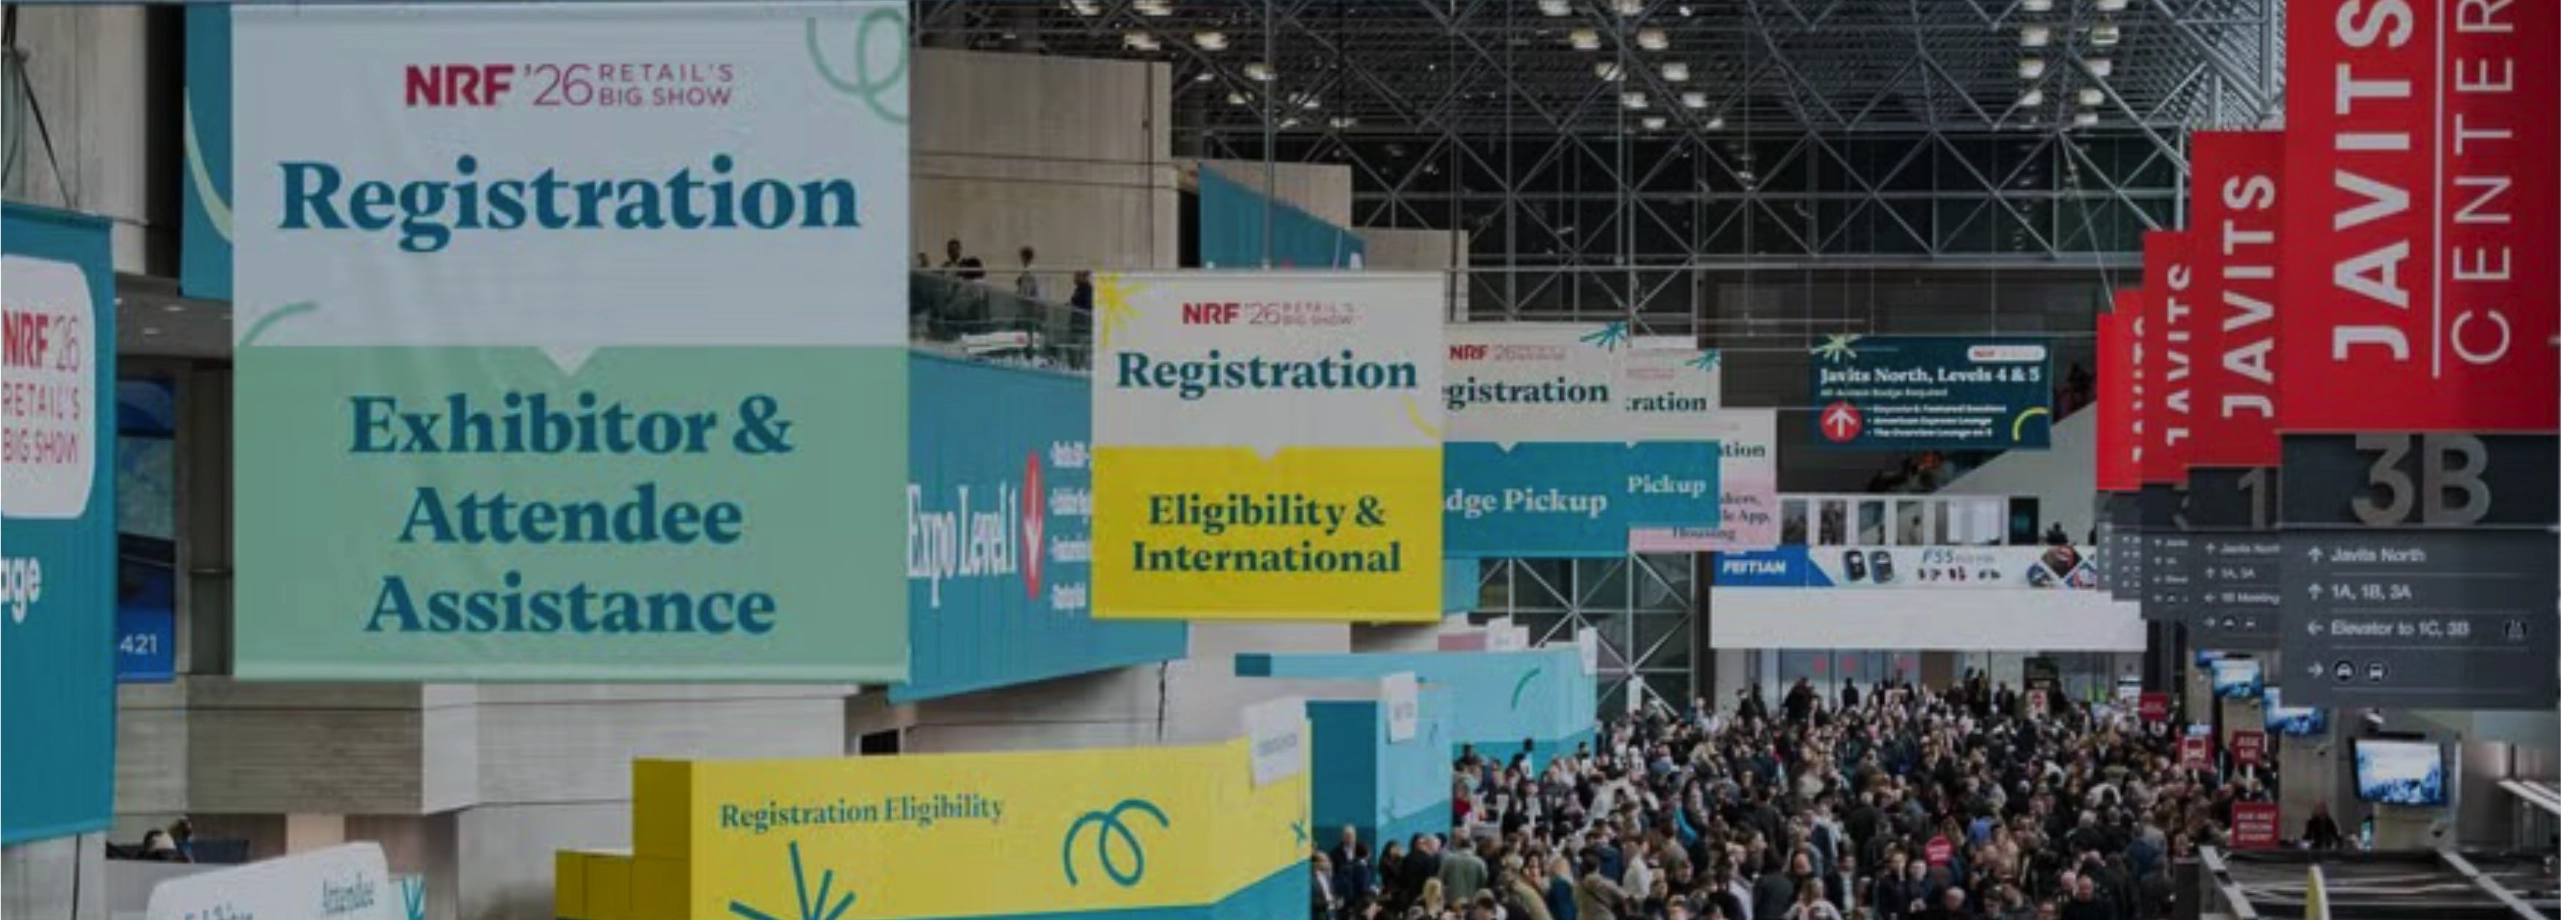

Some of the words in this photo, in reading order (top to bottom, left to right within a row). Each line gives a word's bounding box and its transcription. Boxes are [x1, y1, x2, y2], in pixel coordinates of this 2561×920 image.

[405, 63, 514, 107] NRF
[599, 63, 734, 82] RETAIL'S
[599, 87, 644, 106] BIG
[652, 87, 732, 106] SHOW
[2333, 0, 2414, 360] JAVITS
[2451, 0, 2514, 364] CENTER
[277, 154, 861, 252] Registration
[1182, 302, 1240, 325] NRF
[2222, 173, 2276, 418] JAVITS
[2, 310, 48, 369] NRF
[1449, 345, 1487, 360] NRF
[1116, 350, 1417, 400] Registration
[1820, 366, 1871, 385] Javits
[1874, 366, 1933, 384] North,
[1938, 366, 1993, 383] Levels
[1995, 366, 2007, 382] 4
[2011, 366, 2026, 382] &
[349, 391, 718, 455] Exhibitor
[732, 394, 795, 455] &
[1628, 475, 1706, 498] Pickup
[2351, 433, 2491, 526] 3B
[398, 482, 743, 544] Attendee
[1150, 494, 1345, 536] Eligibility
[1355, 495, 1386, 527] &
[1504, 487, 1608, 518] Pickup
[907, 484, 957, 608] Expo
[958, 481, 1007, 577] Level
[1132, 540, 1402, 572] International
[2330, 548, 2377, 562] Javits
[2381, 548, 2426, 562] North
[363, 570, 777, 634] Assistance
[2331, 584, 2357, 599] 1A,
[2361, 584, 2386, 599] 1B,
[2390, 584, 2412, 599] 3A
[120, 633, 158, 655] 421
[2331, 620, 2393, 635] Elevator
[2397, 620, 2414, 635] to
[2418, 621, 2443, 637] 1C,
[720, 799, 878, 834] Registration
[883, 792, 1004, 826] Eligibility
